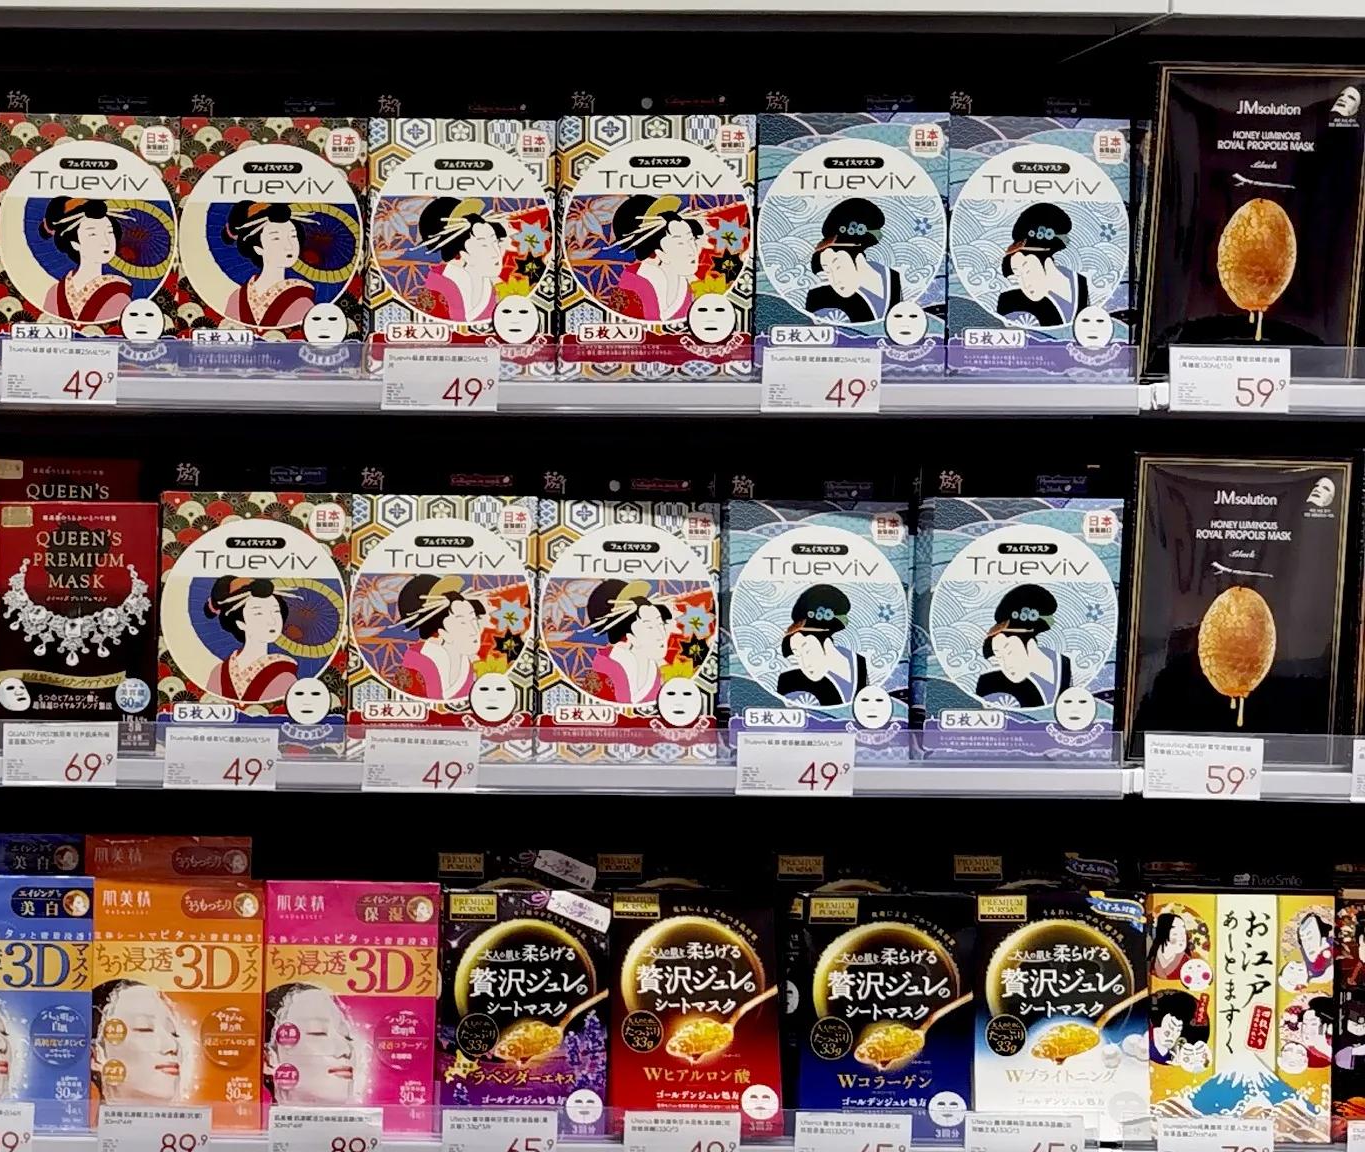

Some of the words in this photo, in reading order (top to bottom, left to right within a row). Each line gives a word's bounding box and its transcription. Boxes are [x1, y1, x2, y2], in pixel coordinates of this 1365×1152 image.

[1236, 101, 1301, 117] JMsolution
[1216, 142, 1245, 152] ROYAL
[1247, 142, 1287, 152] PROPOLIS
[1289, 142, 1315, 152] MASK
[213, 172, 331, 196] Trueviv
[580, 325, 641, 343] 5枚入り
[1209, 520, 1237, 530] HONEY
[1239, 520, 1284, 530] LUMINOUS
[277, 895, 325, 911] 肌美精
[3, 943, 71, 988] 3D
[1240, 910, 1274, 1008] お江戸
[347, 947, 414, 993] 3D
[636, 966, 756, 995] 贅沢ジュレの
[487, 1001, 567, 1016] シートマスク
[1019, 1001, 1104, 1018] シートマスク
[643, 1067, 750, 1085] Wヒアルロン酸
[837, 1074, 932, 1090] Wコラーゲン
